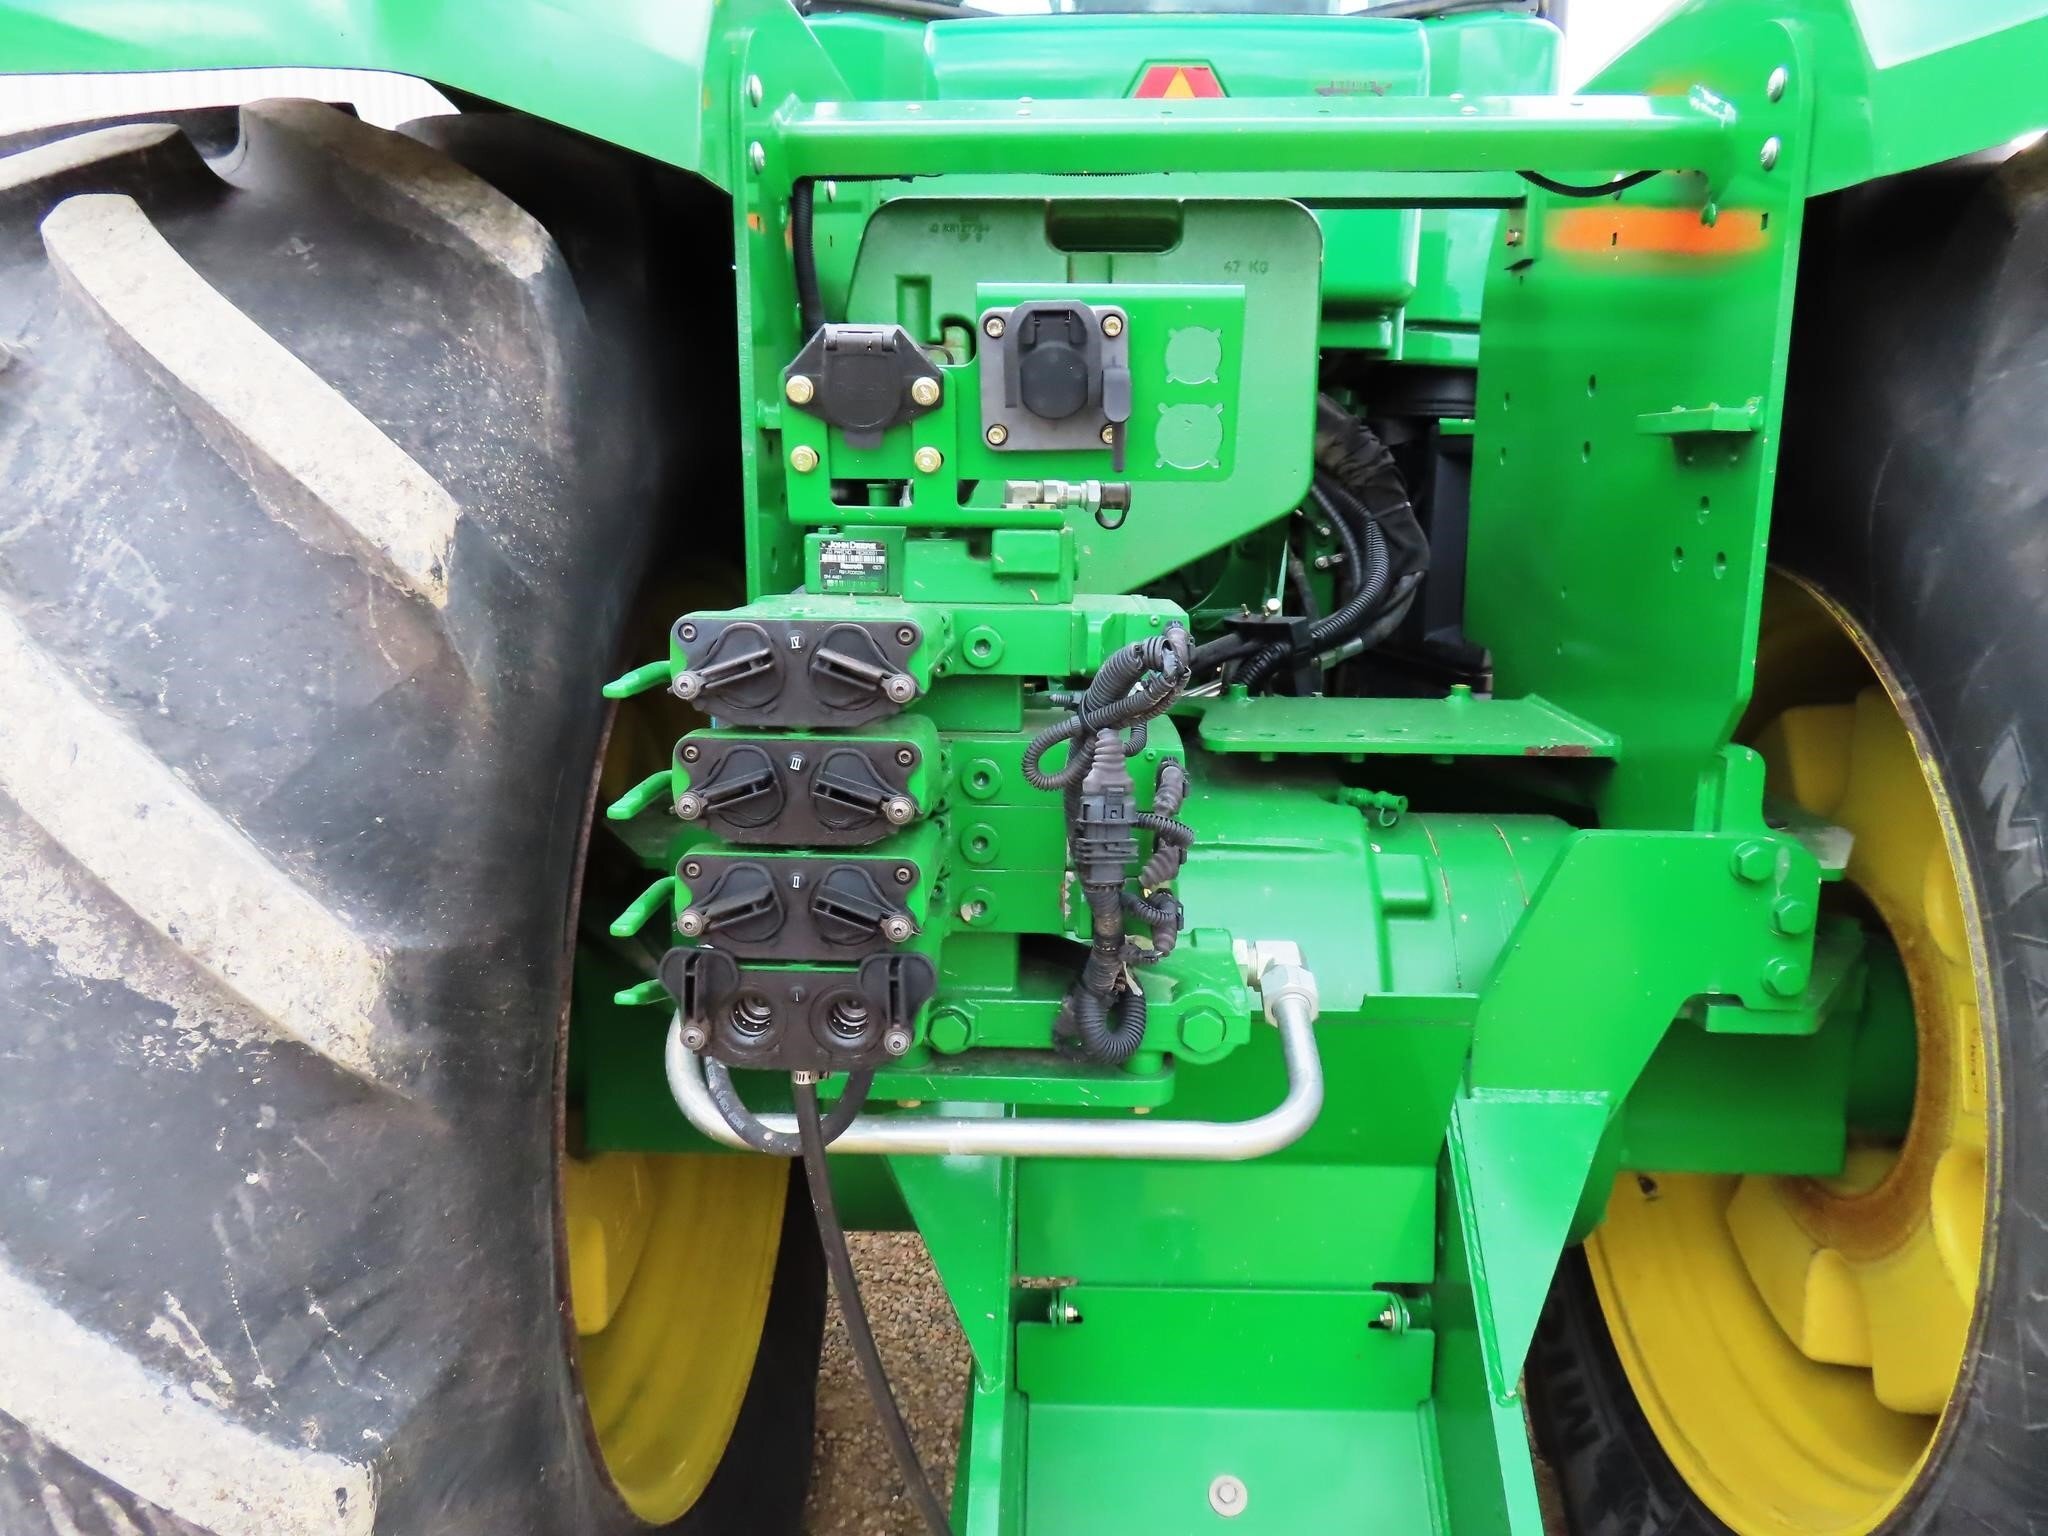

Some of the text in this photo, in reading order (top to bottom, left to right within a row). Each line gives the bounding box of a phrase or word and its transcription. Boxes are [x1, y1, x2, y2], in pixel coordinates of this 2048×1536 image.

[1223, 260, 1270, 275] 47 KG
[790, 635, 802, 649] IV
[789, 757, 802, 771] III
[792, 875, 801, 889] II
